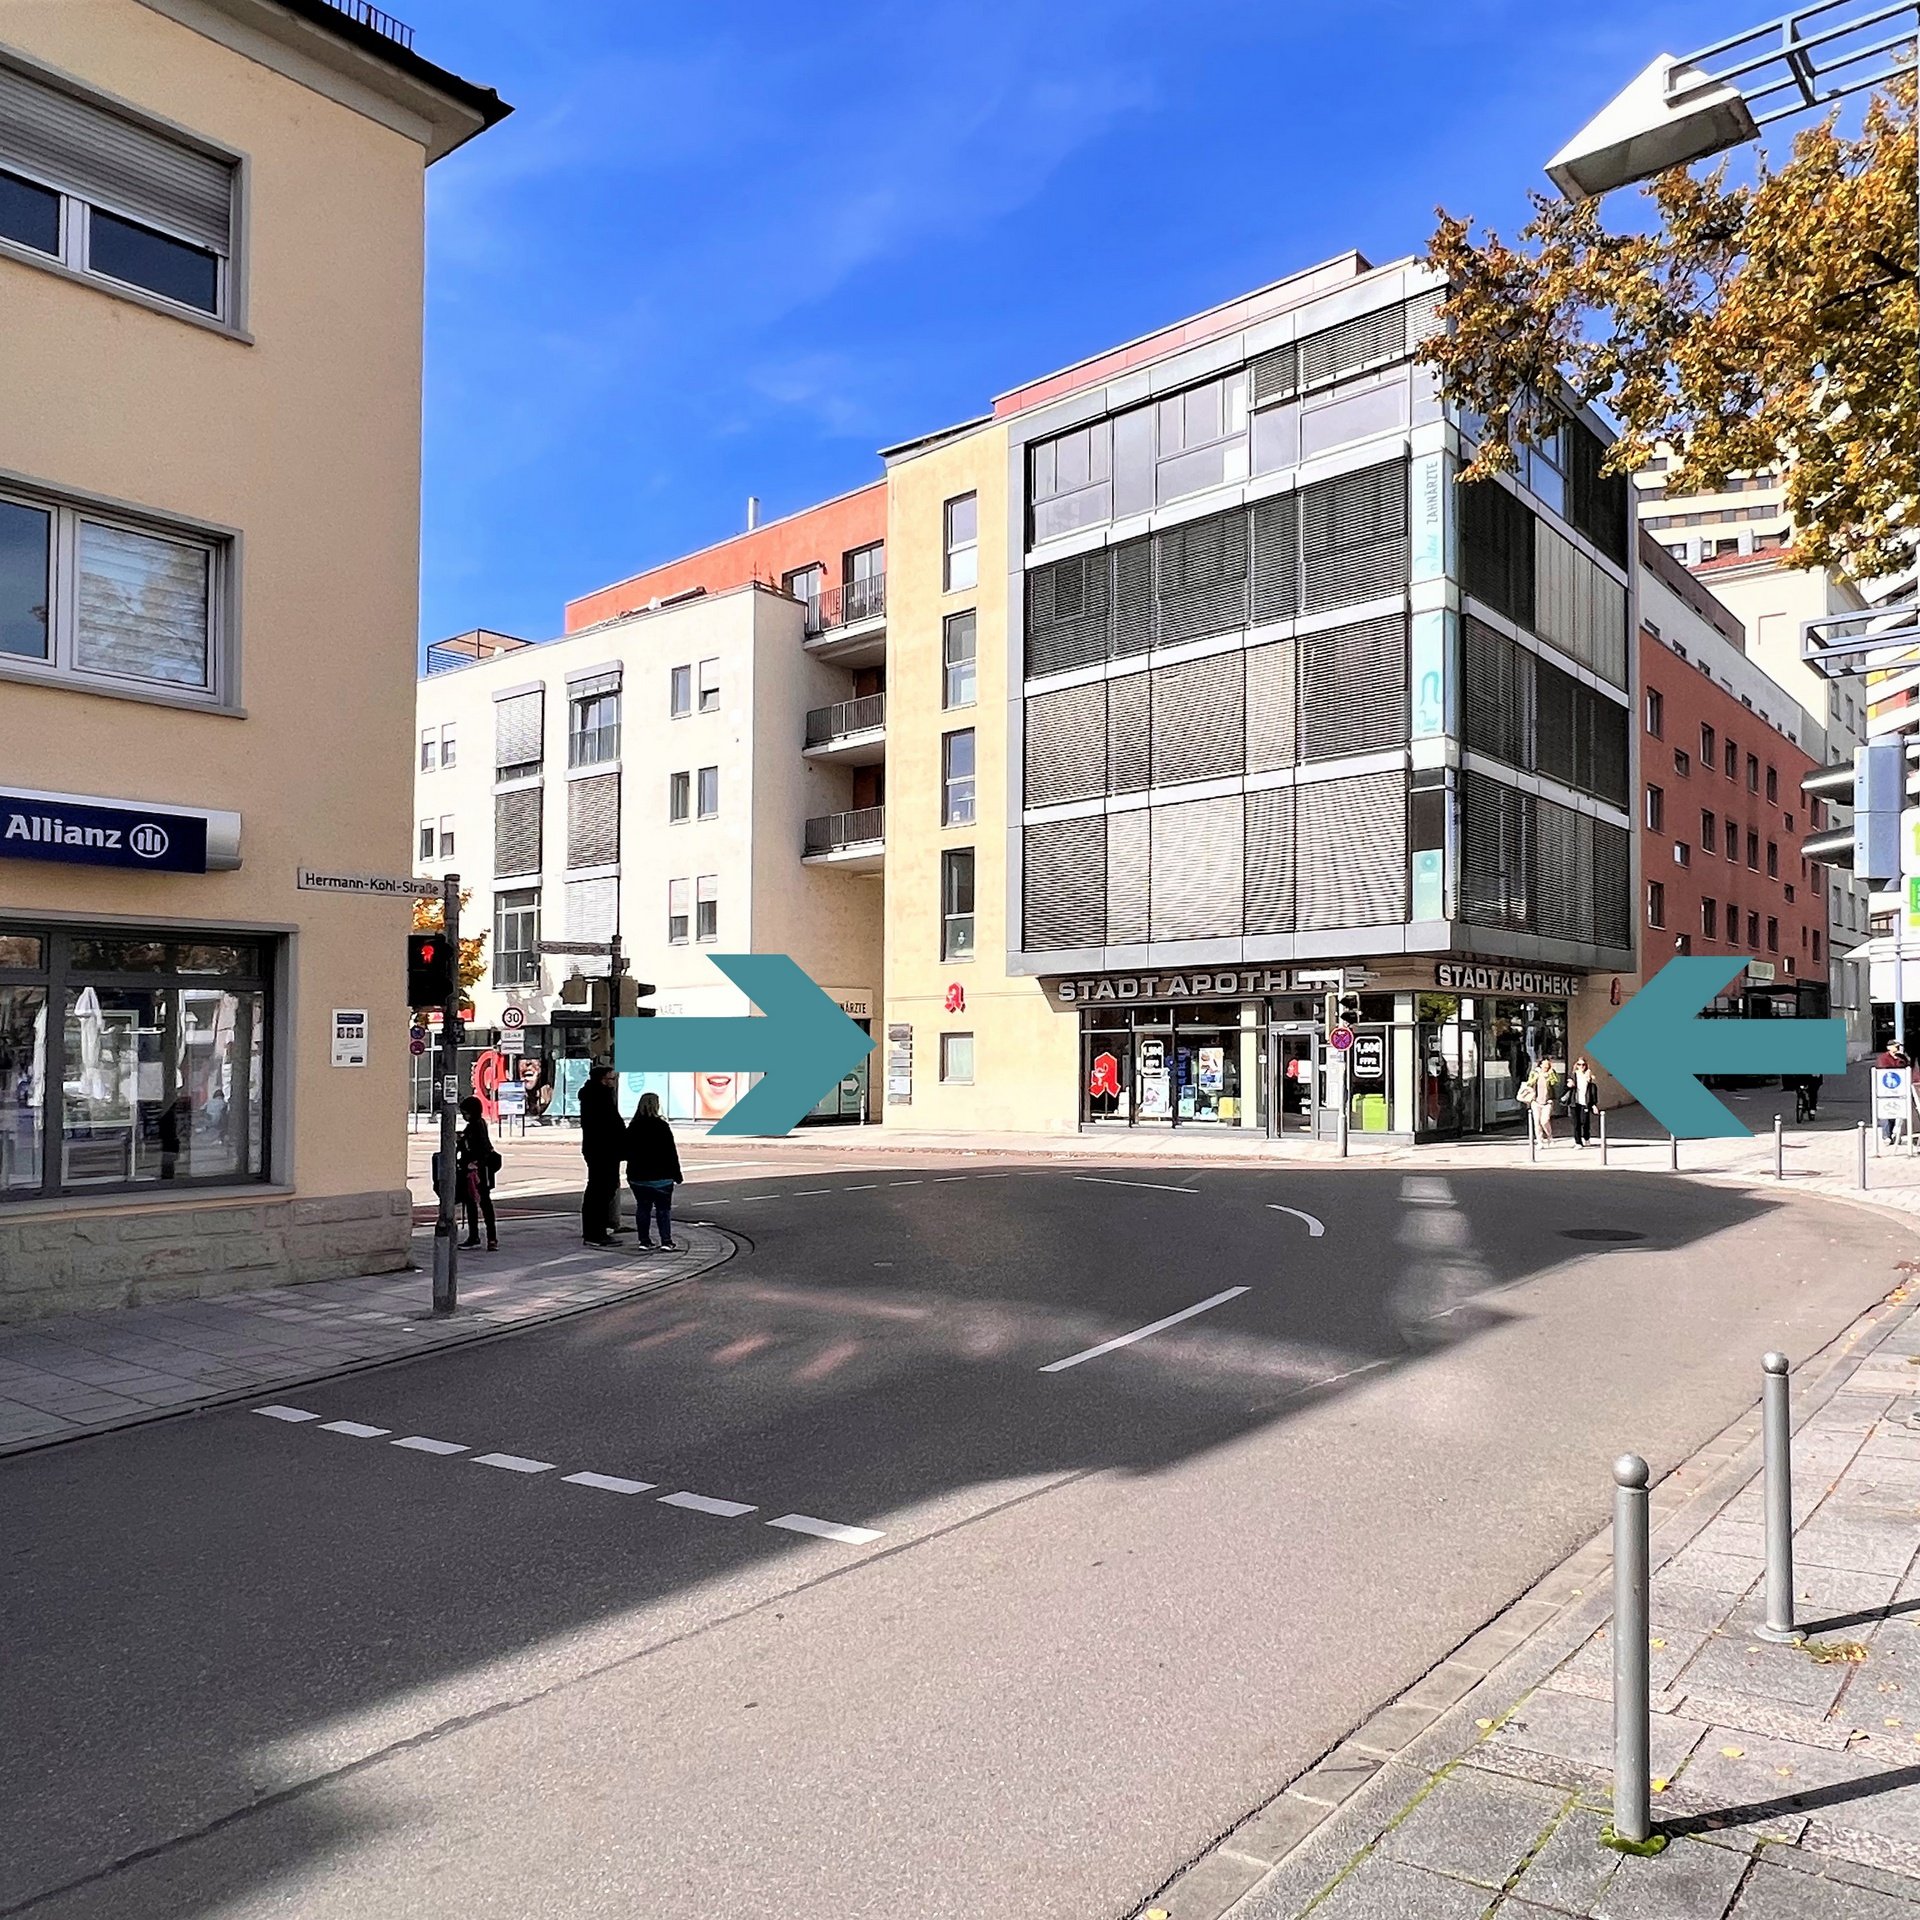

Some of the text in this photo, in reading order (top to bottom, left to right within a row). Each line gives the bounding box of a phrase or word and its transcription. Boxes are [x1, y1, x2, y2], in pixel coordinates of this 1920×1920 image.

[1425, 461, 1438, 525] ZAHNÄRZTE
[5, 814, 122, 848] Allianz
[1058, 976, 1159, 1000] STADT
[1439, 964, 1579, 996] STADT APOTHEKE
[506, 1012, 520, 1023] 30
